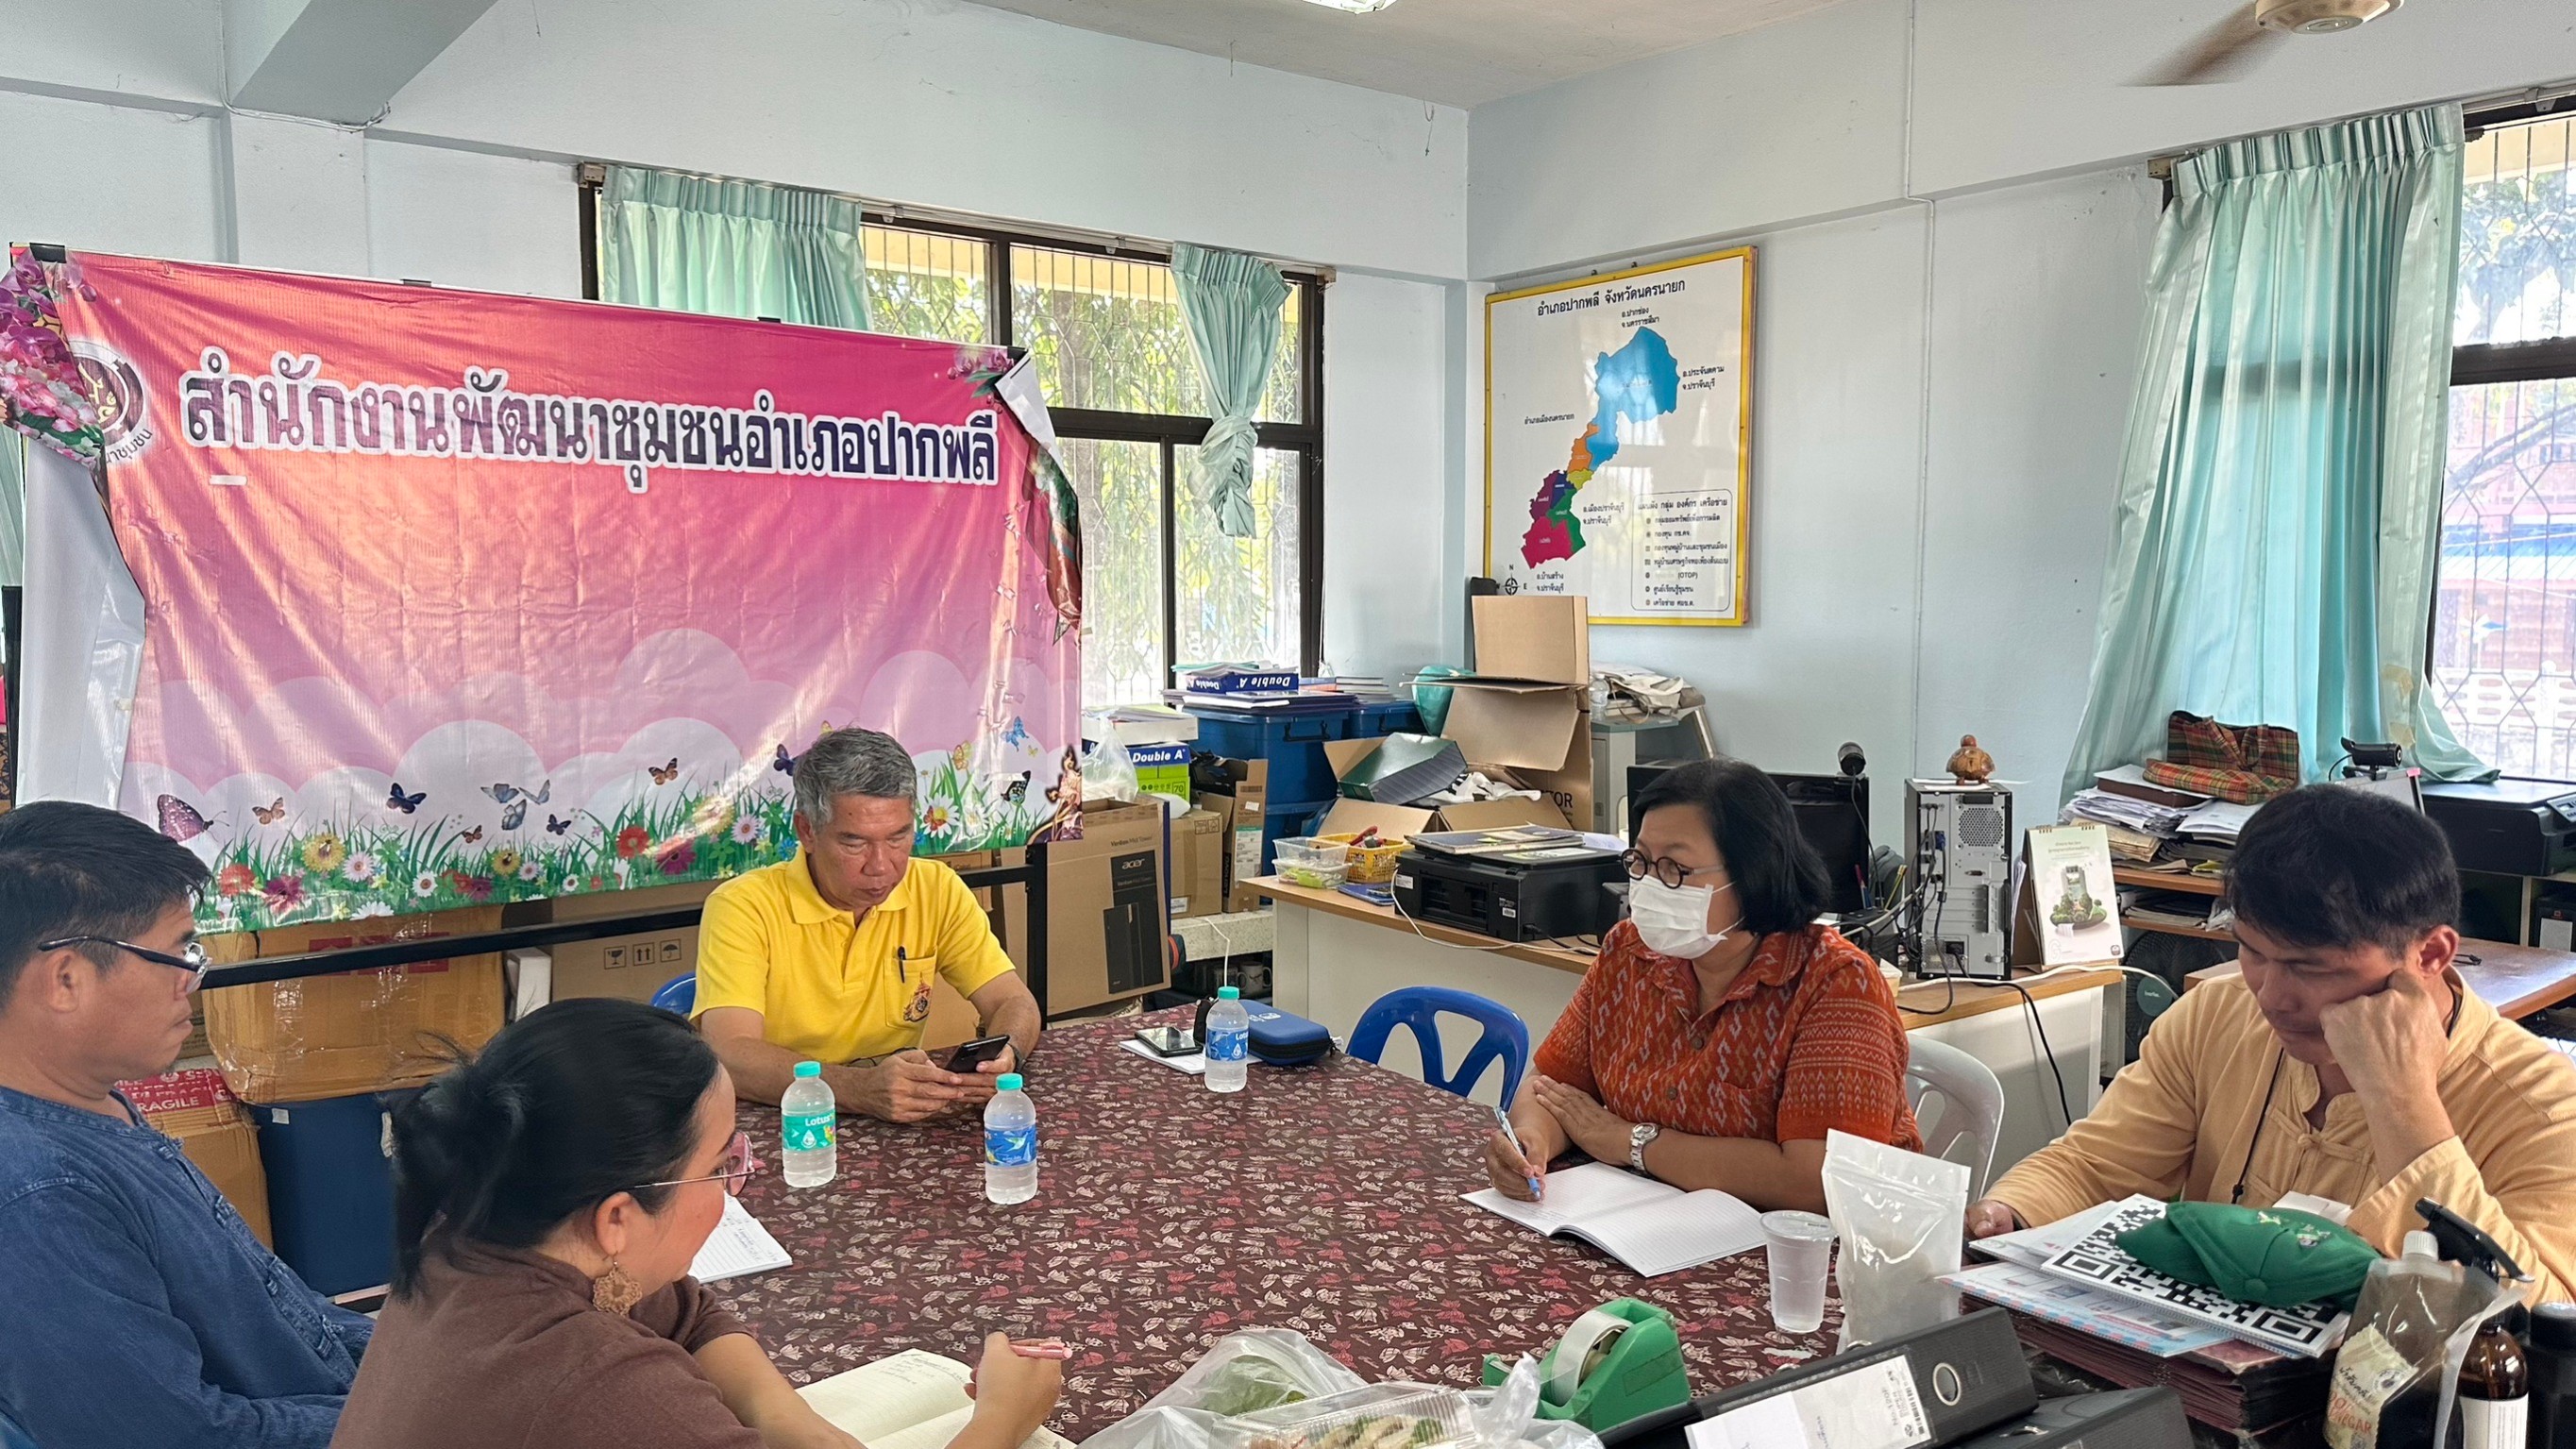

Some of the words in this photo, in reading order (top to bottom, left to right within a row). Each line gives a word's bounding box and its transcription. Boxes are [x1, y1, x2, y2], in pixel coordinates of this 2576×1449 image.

[1538, 291, 1599, 316] อำเภอปากพลี
[1605, 280, 1685, 304] จังหวัดนครนายก
[1622, 307, 1649, 317] อ.ปากช่อง
[185, 352, 998, 489] สำนักงานพัฒนาชุมชนอำเภอปากพลี
[1700, 497, 1727, 507] เครือข่าย
[1251, 676, 1291, 687] Double
[1132, 750, 1171, 763] Double
[1173, 784, 1184, 793] 70
[1122, 858, 1145, 870] acer
